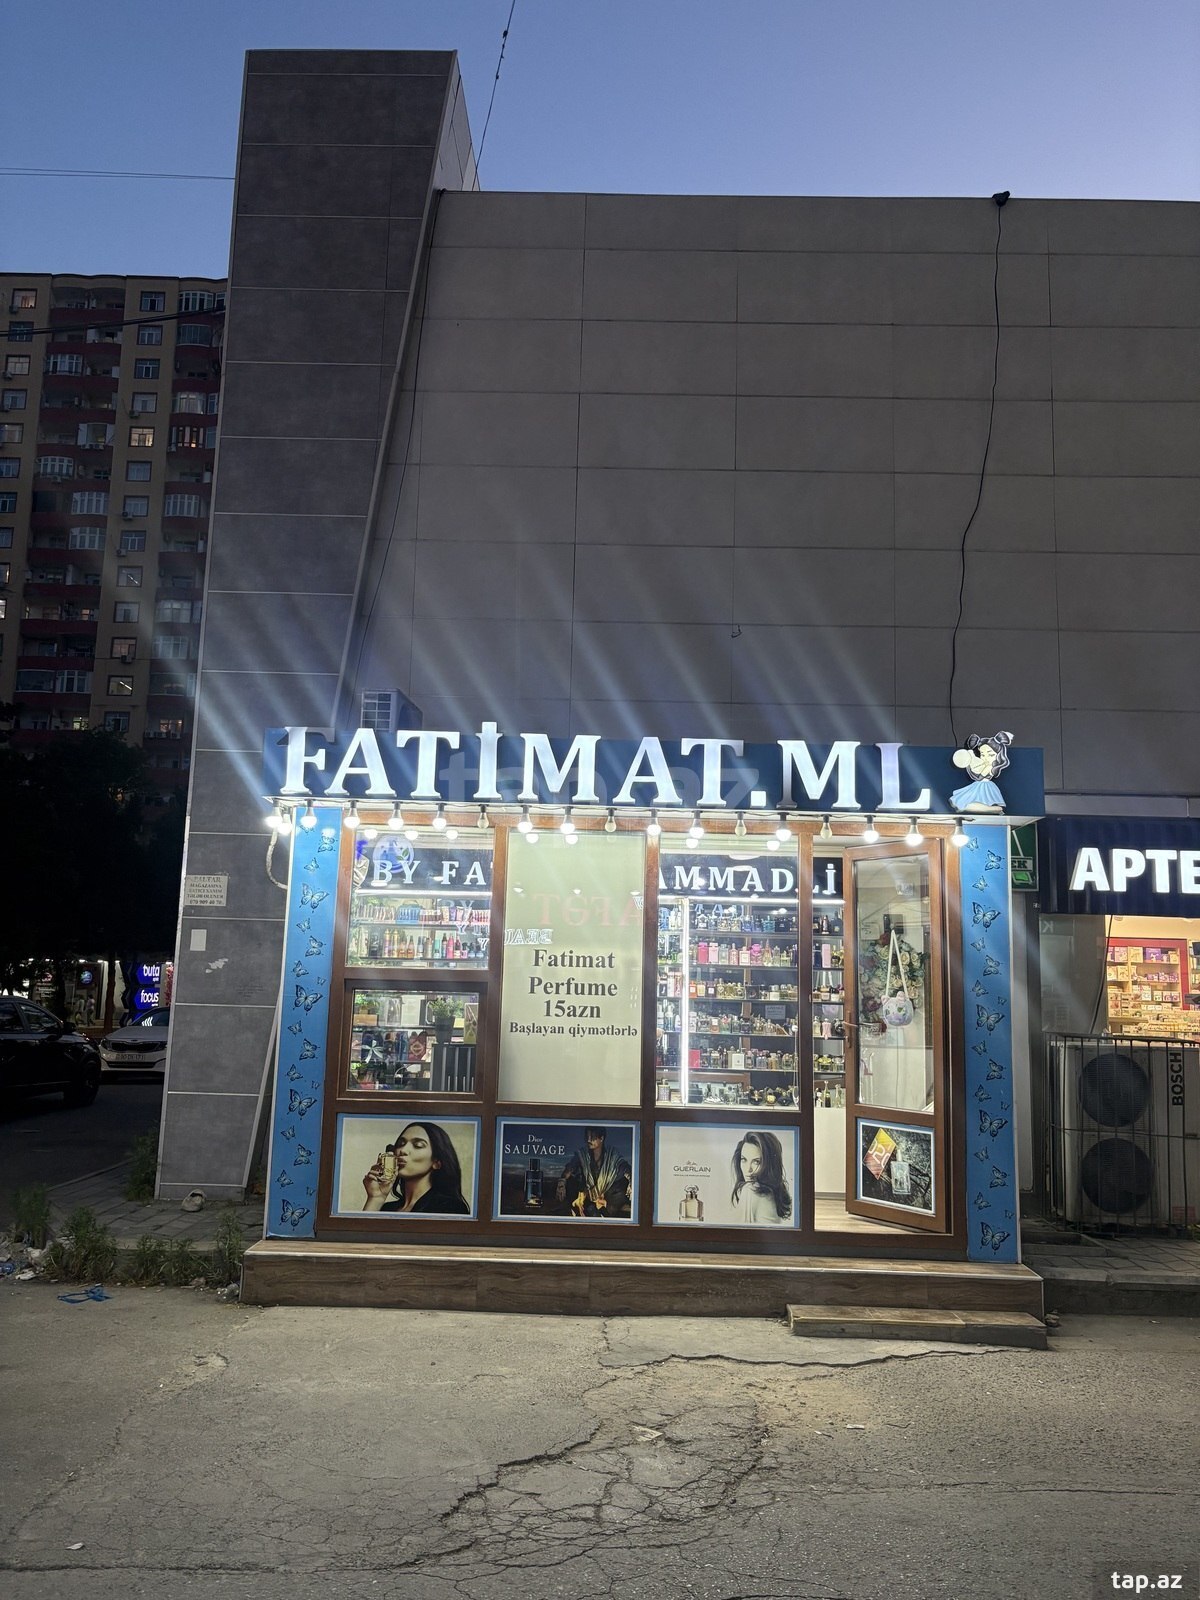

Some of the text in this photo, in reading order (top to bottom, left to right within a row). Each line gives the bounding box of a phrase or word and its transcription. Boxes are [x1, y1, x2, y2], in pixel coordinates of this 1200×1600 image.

[279, 721, 931, 811] FATİMAT.ML
[371, 860, 421, 885] BY
[441, 861, 494, 885] FA
[1069, 847, 1200, 894] APTE
[533, 949, 615, 969] Fatimat
[143, 964, 160, 977] buta
[528, 976, 618, 996] Perfume
[140, 989, 159, 1003] focus
[544, 999, 602, 1018] 15azn
[509, 1022, 638, 1038] Başlayan qiymətlərlə
[1169, 1052, 1184, 1106] BOSCH
[528, 1134, 543, 1143] Dior
[504, 1143, 565, 1155] SAUVAGE
[673, 1165, 711, 1173] GUERLAIN
